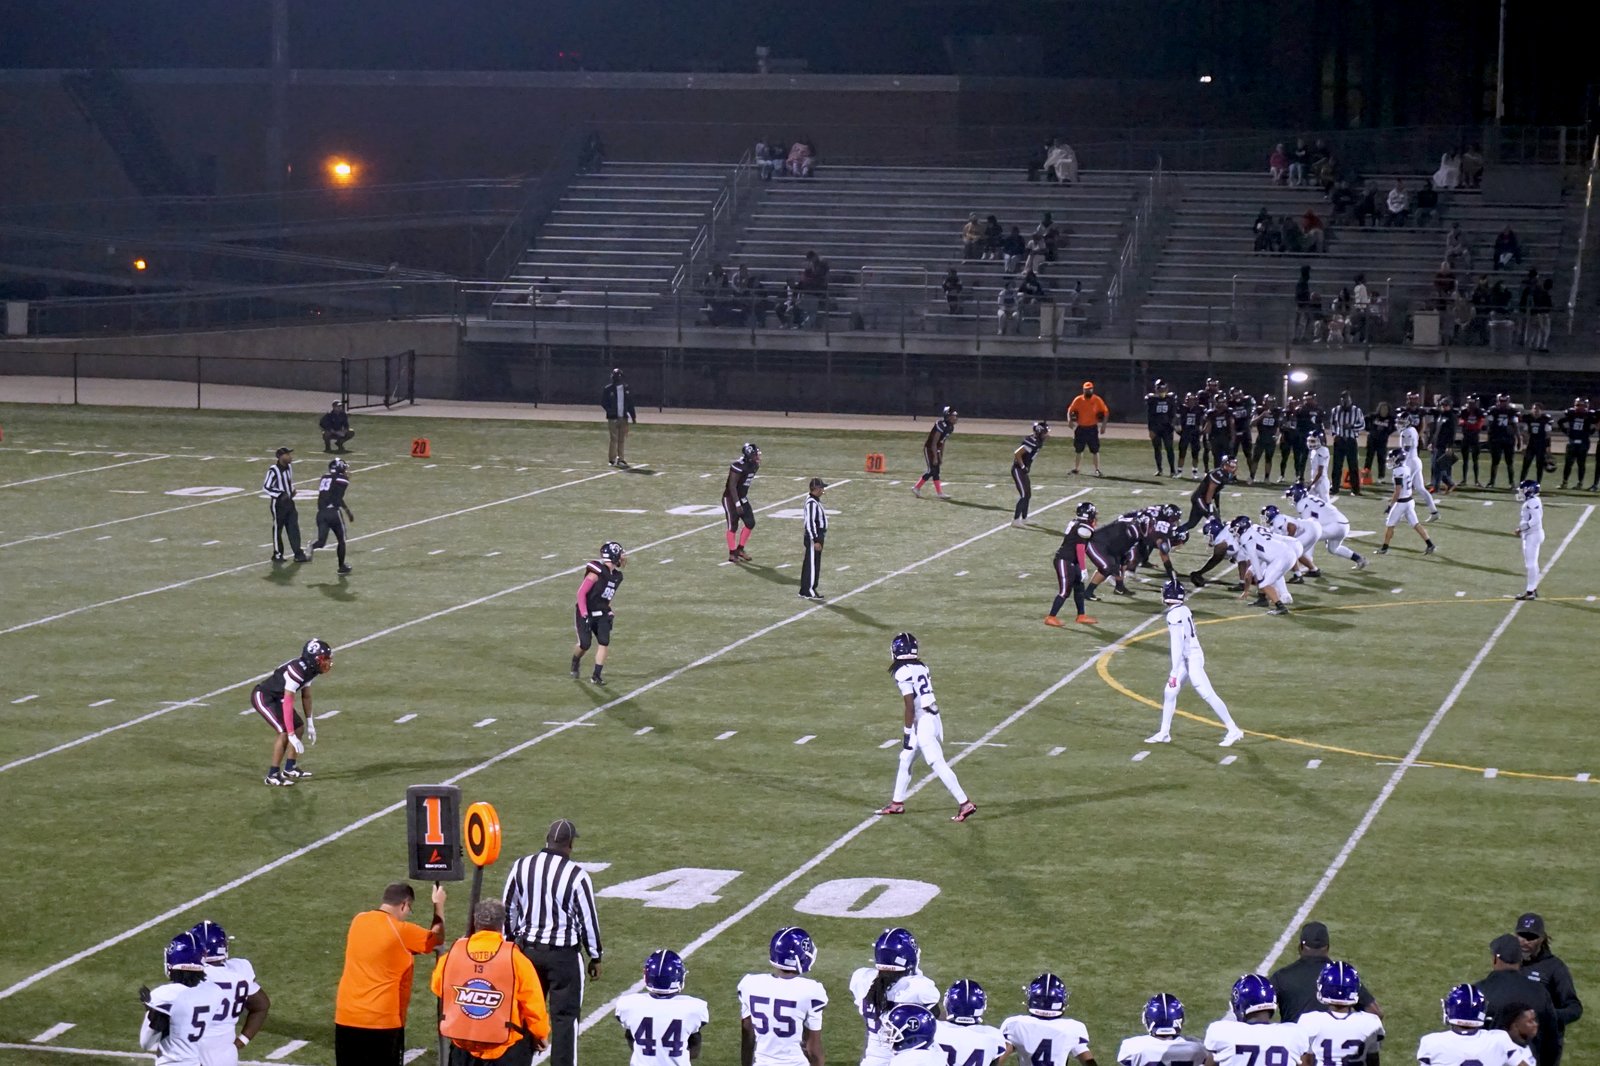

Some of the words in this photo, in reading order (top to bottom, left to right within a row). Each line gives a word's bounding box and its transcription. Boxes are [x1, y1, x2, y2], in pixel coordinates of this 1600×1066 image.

[411, 440, 427, 455] 20
[867, 455, 883, 470] 30
[423, 796, 445, 846] 1
[474, 964, 484, 974] 13
[211, 980, 249, 1021] 58
[458, 990, 502, 1006] MCC
[187, 1005, 210, 1042] 5
[749, 995, 797, 1038] 55
[634, 1017, 684, 1057] 44
[1031, 1038, 1055, 1066] 4
